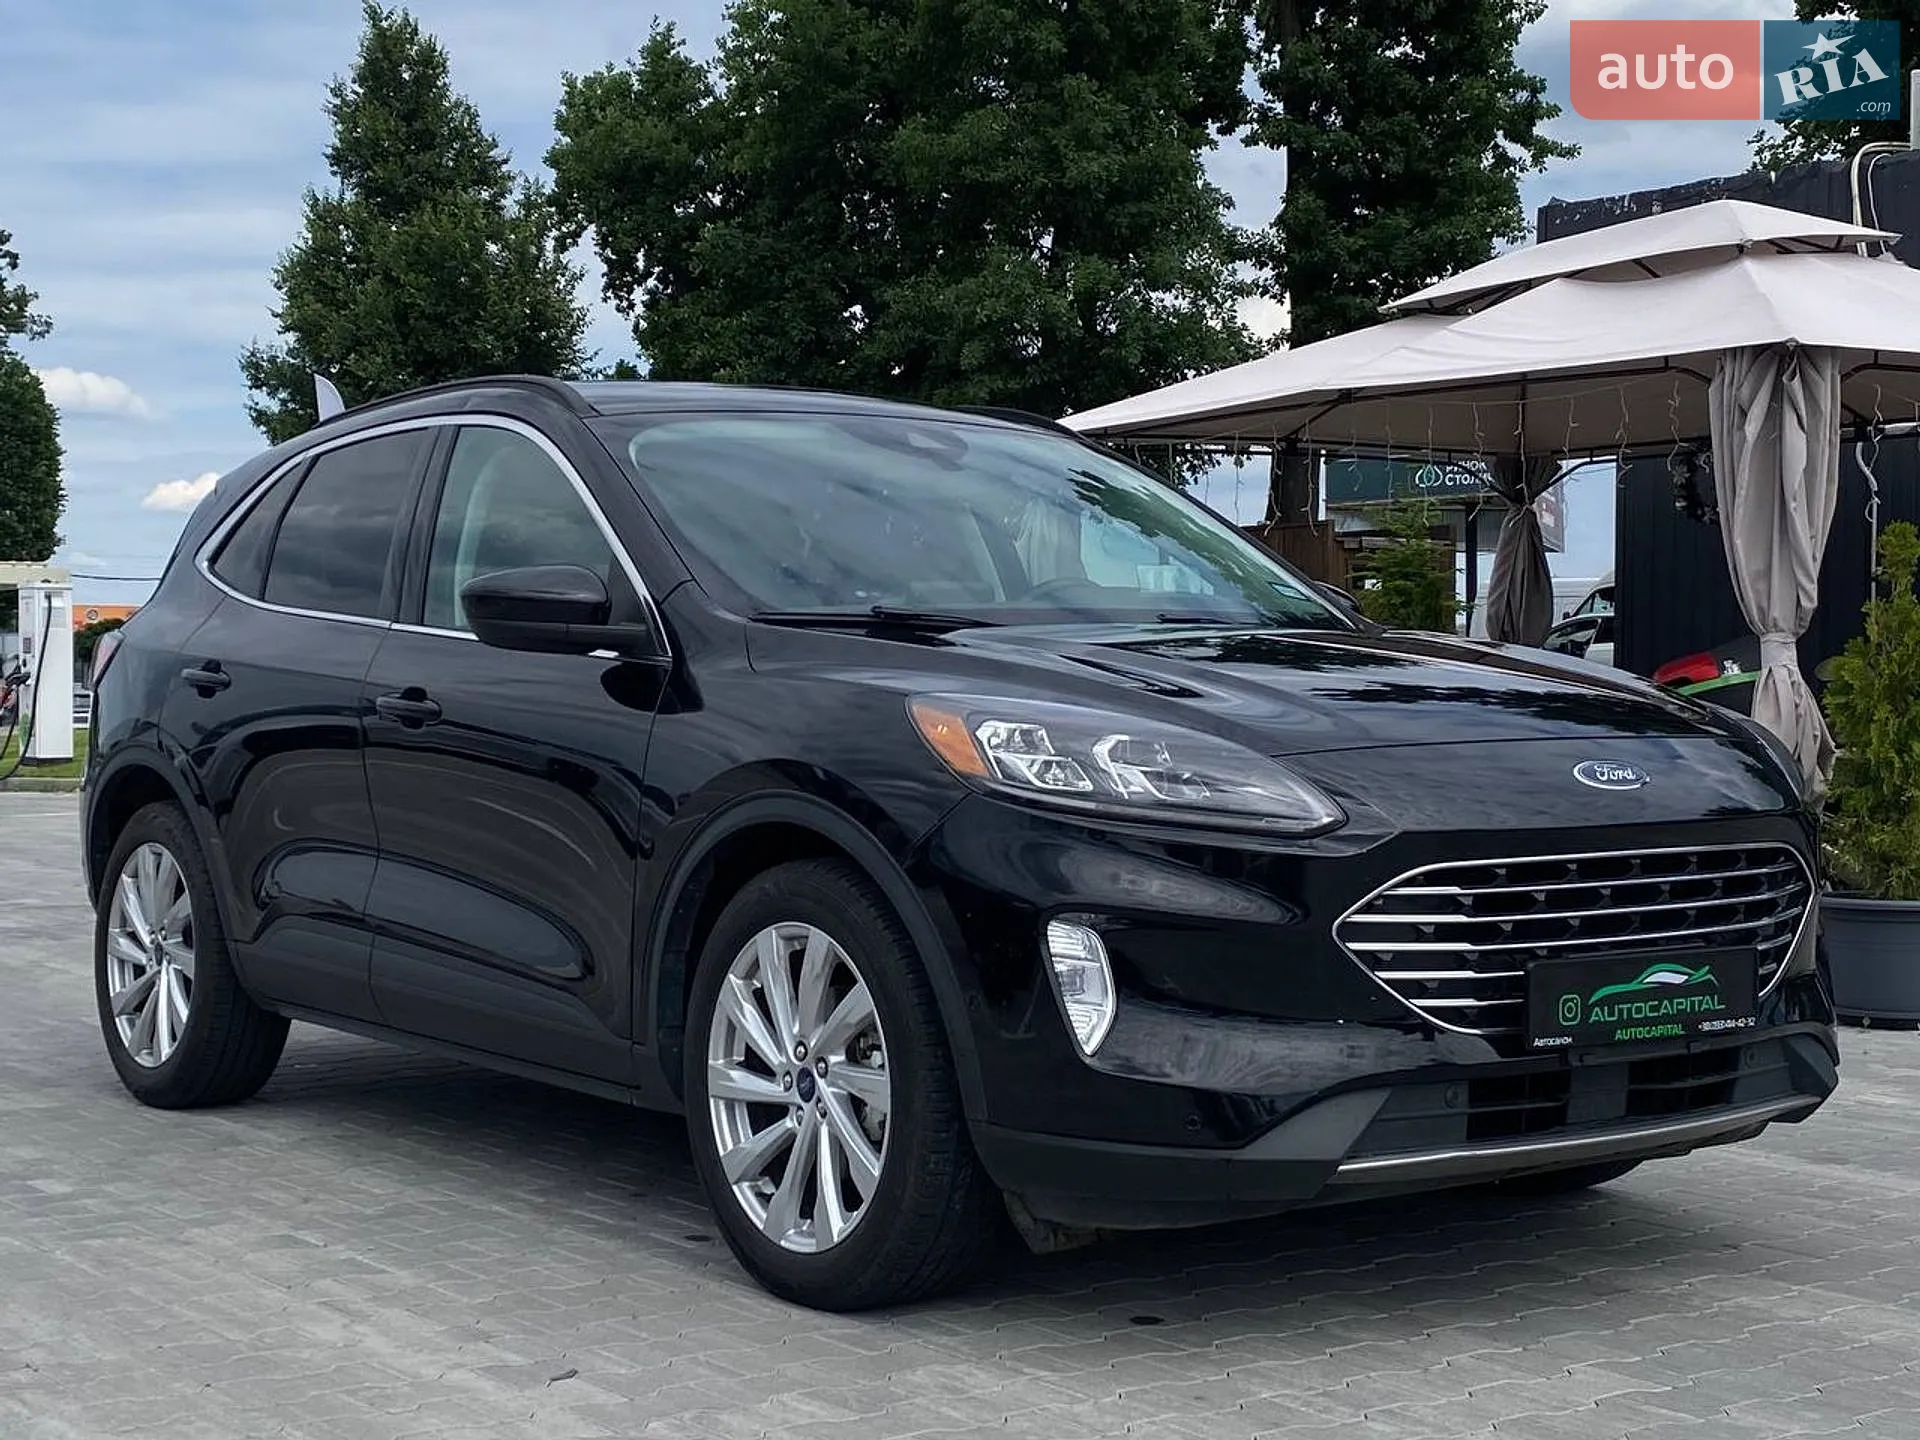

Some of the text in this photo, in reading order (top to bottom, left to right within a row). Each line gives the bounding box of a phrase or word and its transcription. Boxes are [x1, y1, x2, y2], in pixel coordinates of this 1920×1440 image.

[1594, 764, 1636, 781] Ford
[1588, 994, 1726, 1023] AUTOCAPITAL
[1615, 1023, 1686, 1041] AUTOCAPITAL
